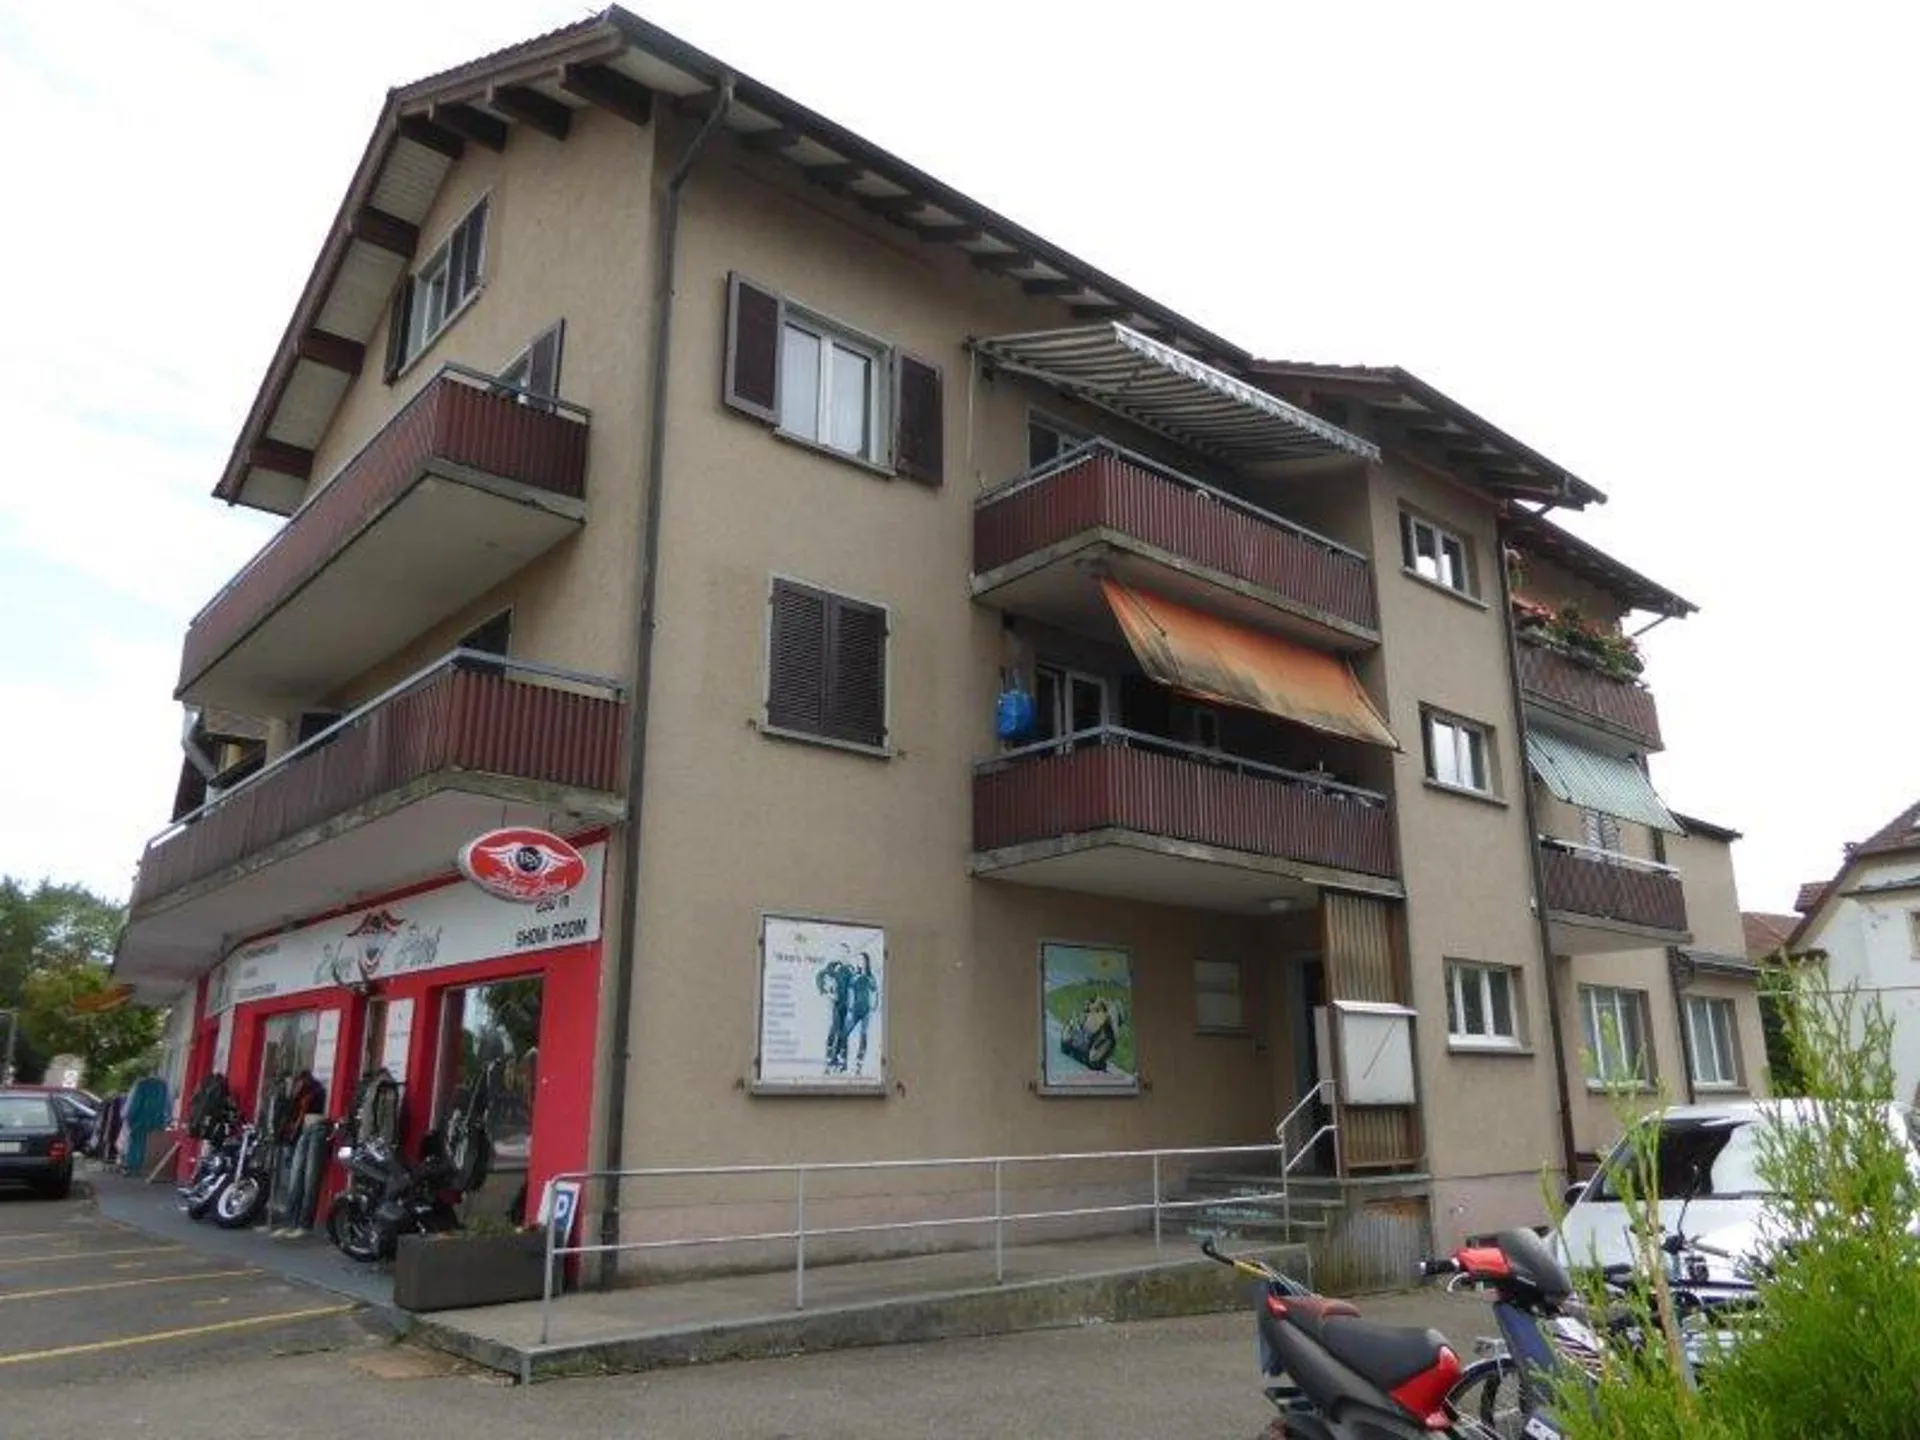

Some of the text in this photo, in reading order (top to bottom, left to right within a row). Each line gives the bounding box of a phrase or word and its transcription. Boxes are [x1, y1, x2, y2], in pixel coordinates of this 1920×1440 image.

[515, 917, 587, 947] SHOW ROOM
[554, 1194, 570, 1218] P
